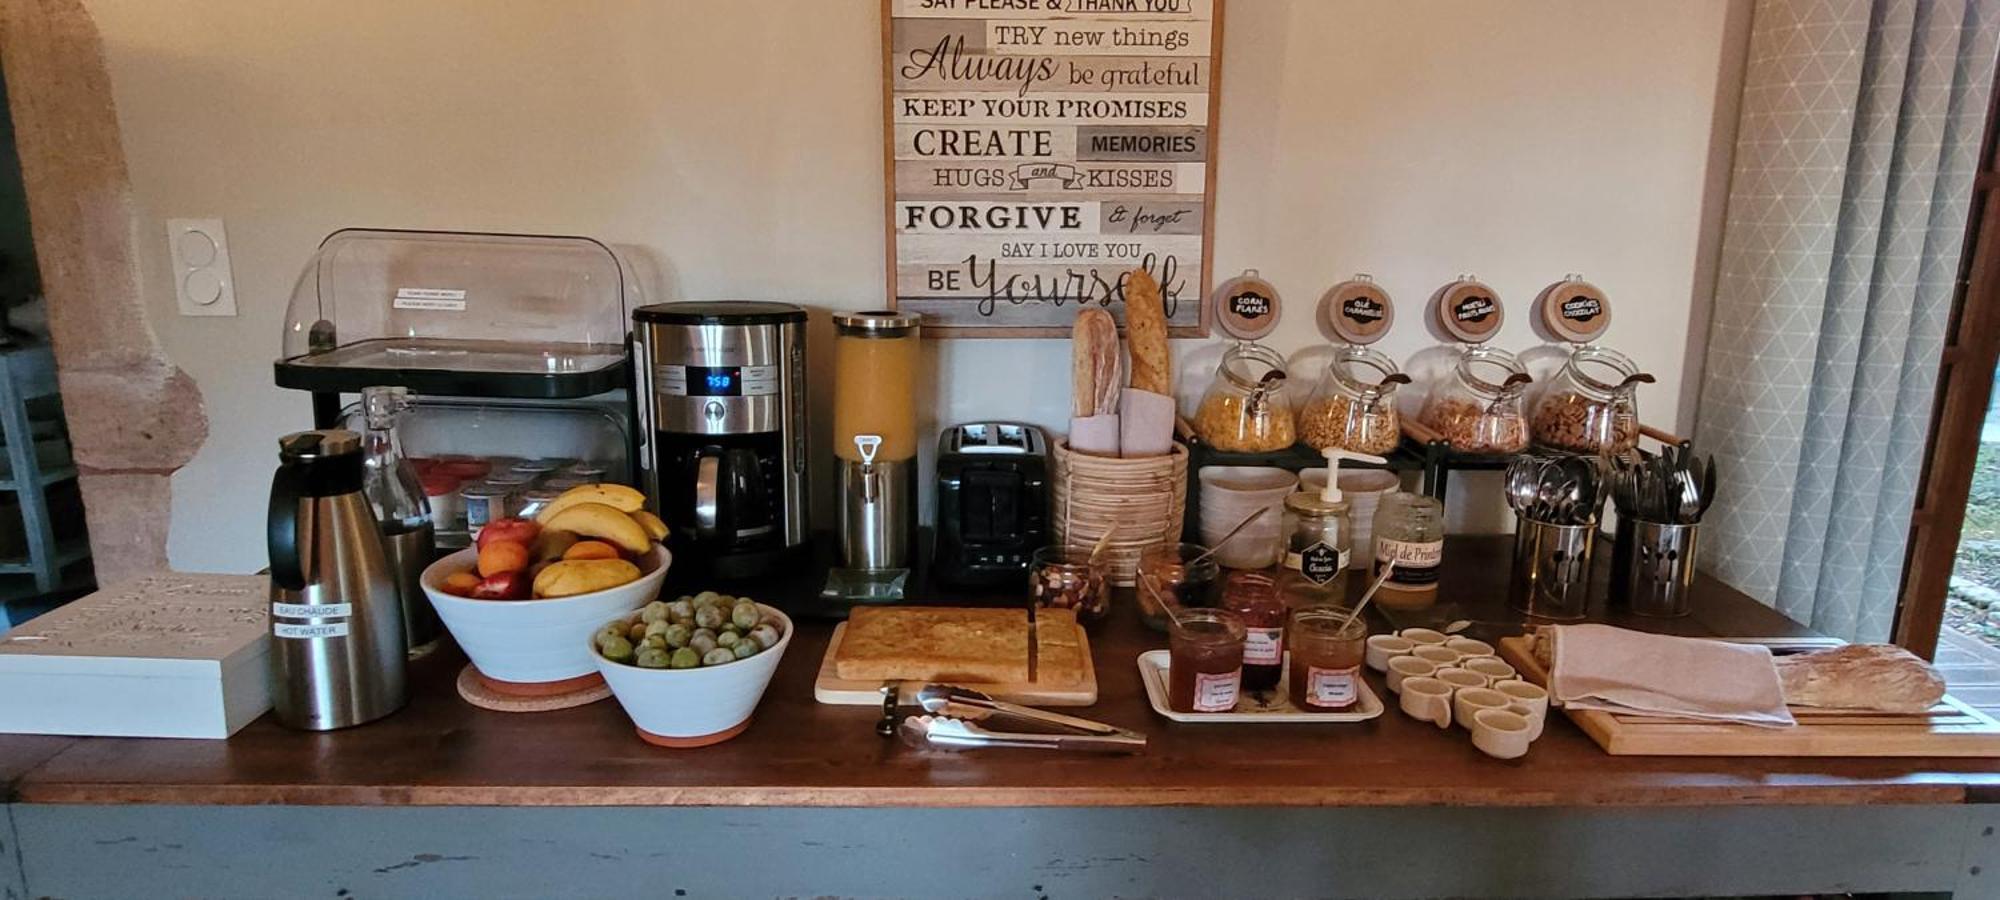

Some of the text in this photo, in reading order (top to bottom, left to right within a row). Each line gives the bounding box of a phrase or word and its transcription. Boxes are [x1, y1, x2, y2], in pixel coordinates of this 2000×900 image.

[964, 0, 1040, 10] PLEASE
[1046, 0, 1062, 10] &
[1077, 0, 1138, 11] THANK
[995, 26, 1189, 50] TRY new things
[901, 34, 1200, 98] Always be grateful
[903, 98, 1187, 118] KEEP YOUR PROMISES
[913, 129, 1196, 157] CREATE MEMORIES
[933, 164, 1173, 188] HUGS and KISSES
[905, 205, 1082, 230] FORGIVE
[1129, 206, 1192, 233] forget
[1001, 243, 1142, 258] SAY I LOVE YOU
[928, 270, 961, 291] BE
[1235, 304, 1269, 314] FLAKES
[1237, 297, 1264, 305] CORN
[279, 606, 339, 616] EAU CHAUDE
[281, 626, 337, 636] HOT WATER
